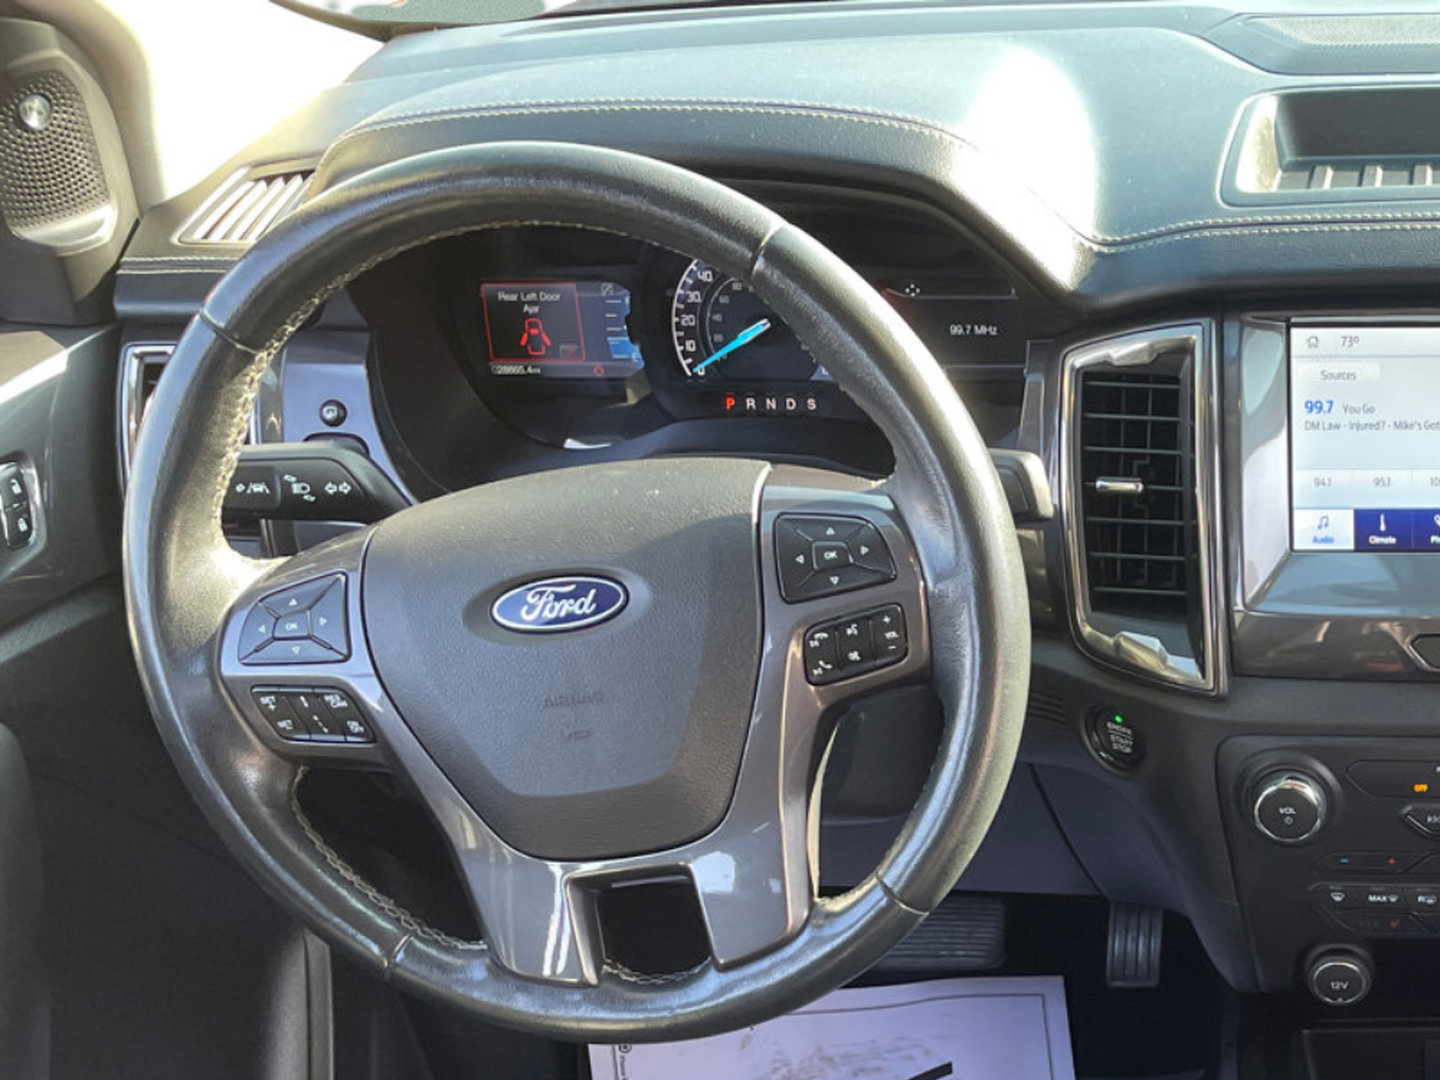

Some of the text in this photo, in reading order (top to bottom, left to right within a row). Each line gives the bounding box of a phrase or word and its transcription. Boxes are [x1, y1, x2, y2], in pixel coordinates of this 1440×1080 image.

[498, 291, 562, 302] Rear Left Door
[686, 291, 701, 303] 30
[523, 303, 540, 314] Ajar
[680, 314, 696, 327] 20
[949, 324, 998, 336] 99.7 MHz
[685, 340, 696, 352] 10
[1320, 370, 1357, 381] Sources
[746, 398, 757, 410] R
[766, 398, 777, 410] N
[785, 398, 797, 410] D
[806, 398, 817, 410] S
[1303, 400, 1376, 414] 99.7 You Go
[1321, 420, 1341, 431] Law
[1348, 419, 1387, 432] Injured?
[1393, 419, 1423, 431] Mike's
[1423, 419, 1440, 430] Got
[1312, 535, 1335, 544] Audio
[1368, 535, 1397, 545] Climate
[824, 550, 838, 560] OK
[519, 583, 598, 623] Ford
[285, 622, 298, 631] OK
[1279, 806, 1297, 815] VOL
[1368, 893, 1388, 903] MAX
[1330, 980, 1350, 990] 12V
